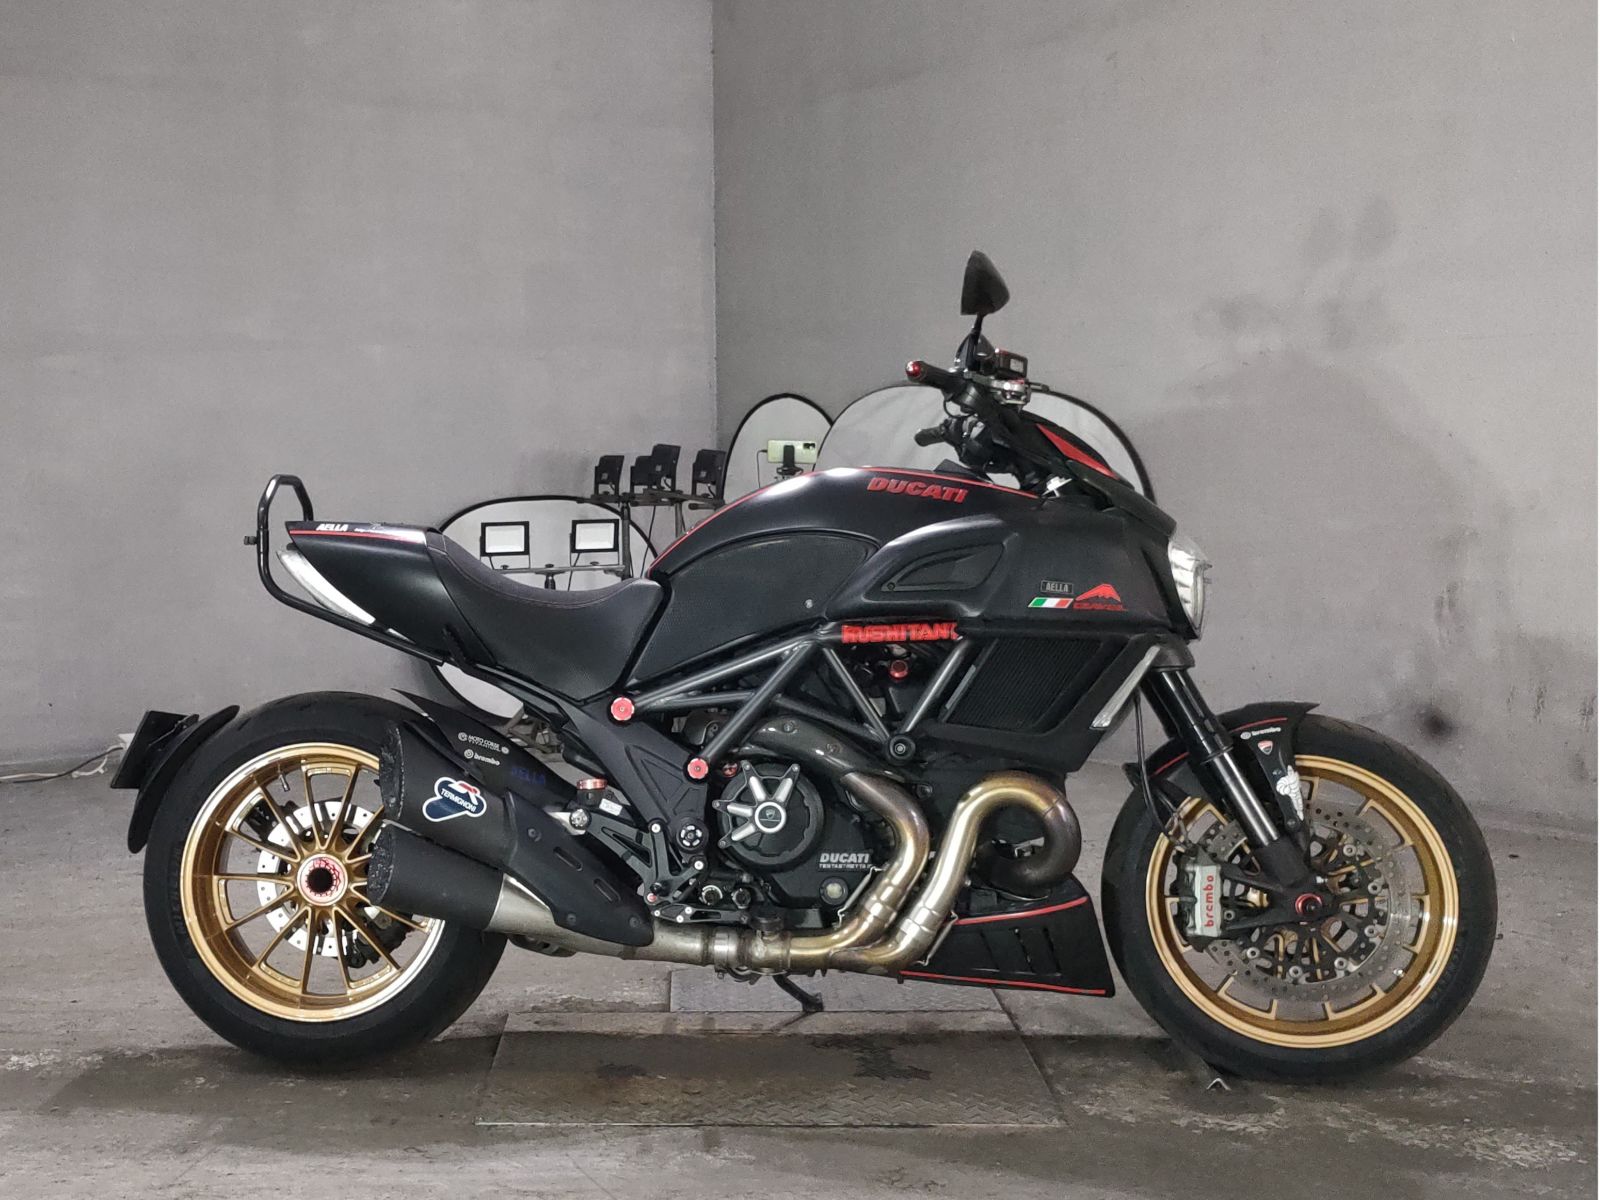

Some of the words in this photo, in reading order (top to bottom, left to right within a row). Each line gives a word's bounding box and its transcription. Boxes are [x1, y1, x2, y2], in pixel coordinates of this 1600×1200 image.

[867, 477, 968, 503] DUCATI
[1045, 582, 1069, 593] AELLA
[474, 752, 500, 766] brembo
[820, 853, 870, 863] DUCATI
[1203, 875, 1214, 928] brembo
